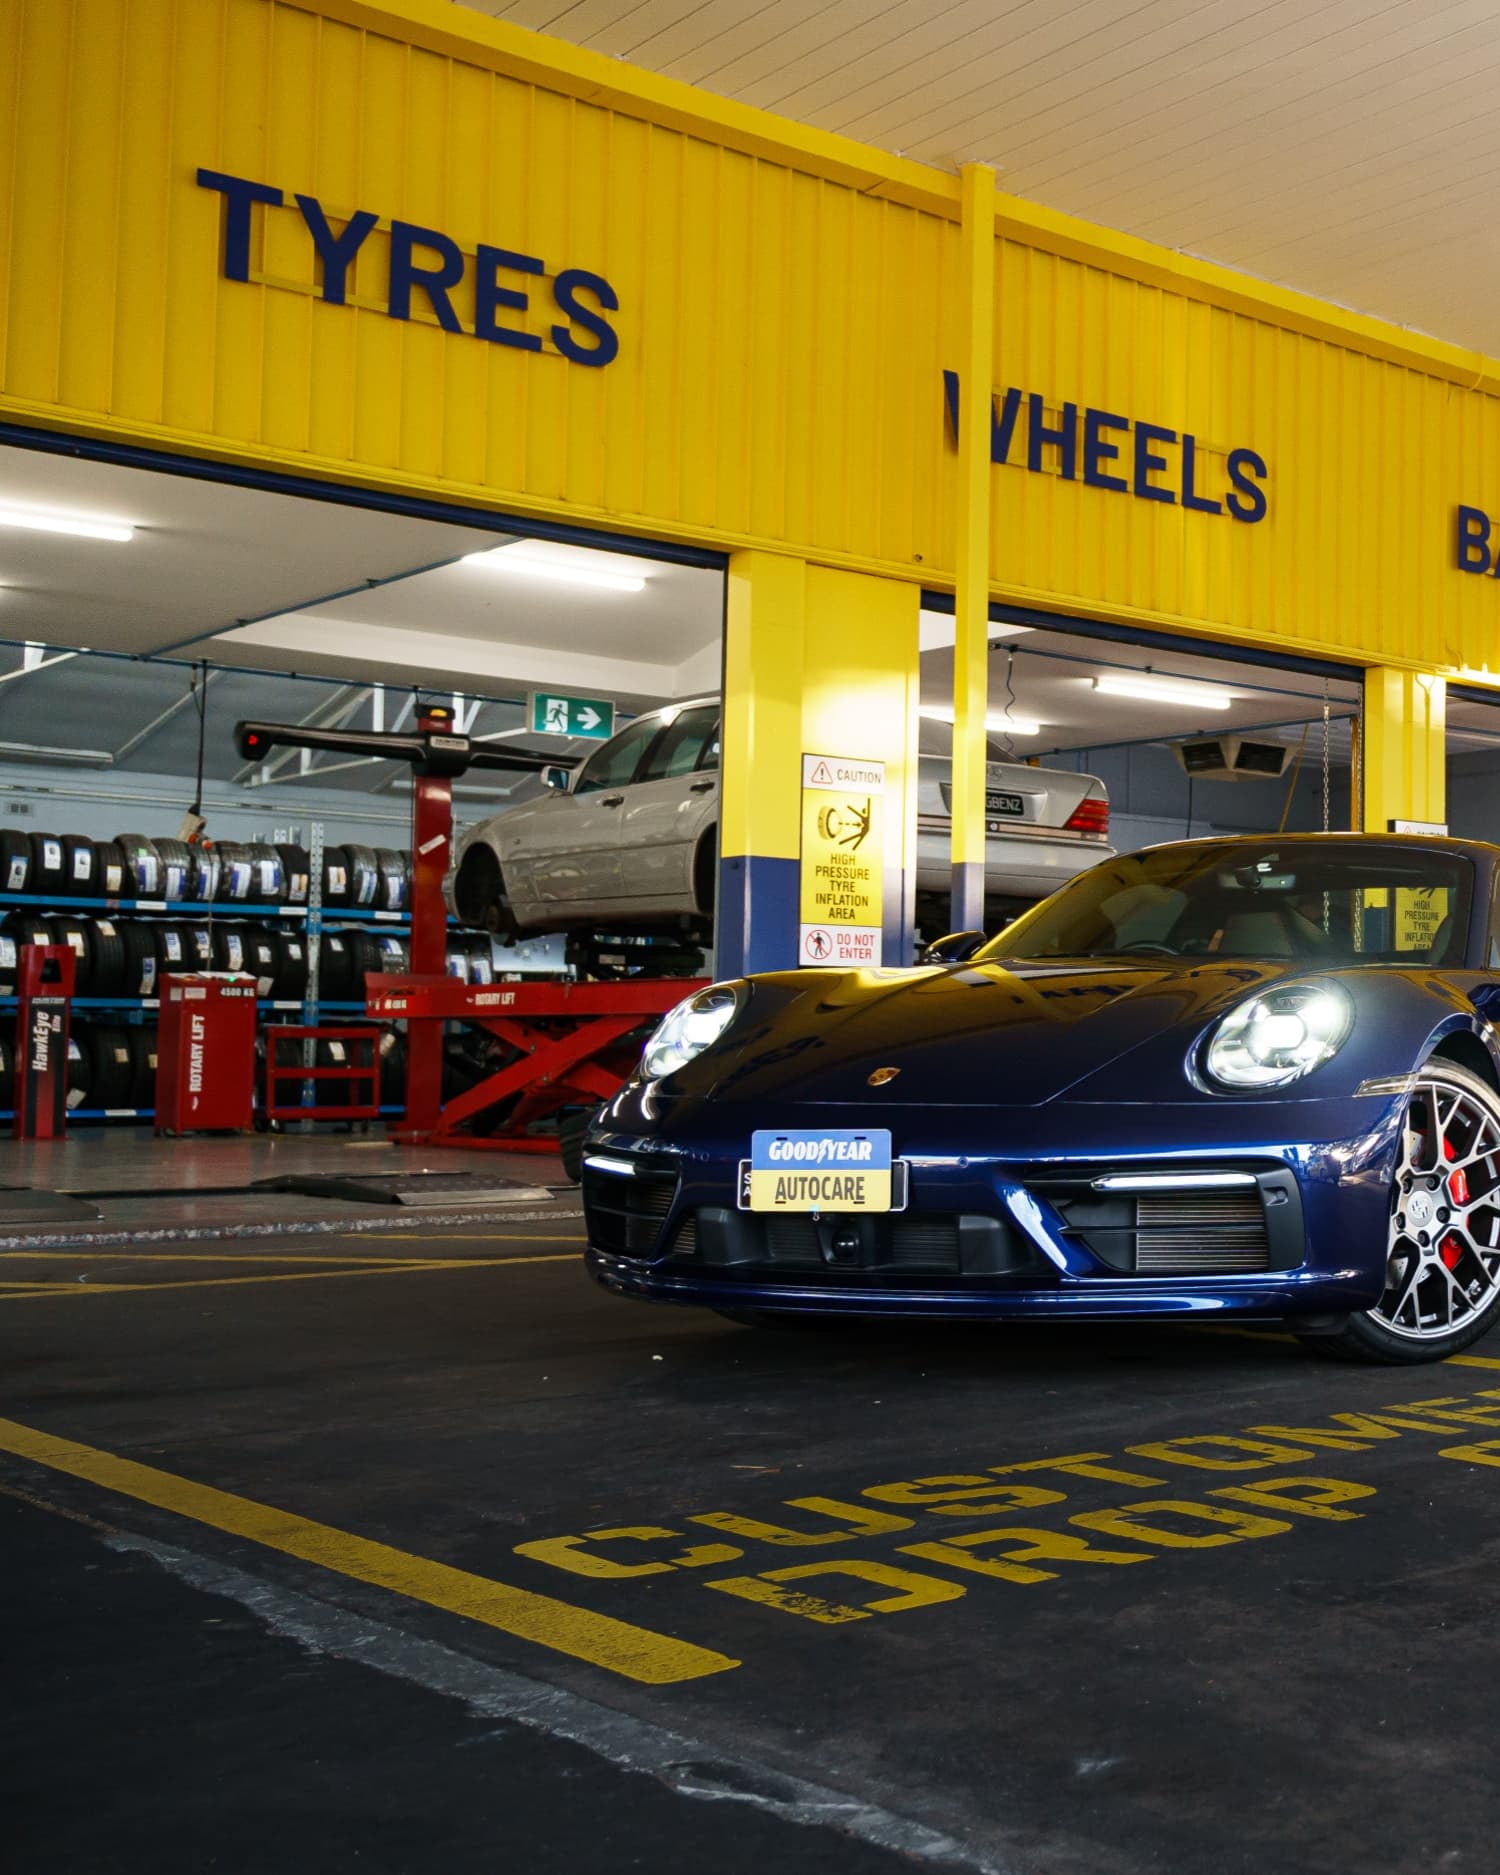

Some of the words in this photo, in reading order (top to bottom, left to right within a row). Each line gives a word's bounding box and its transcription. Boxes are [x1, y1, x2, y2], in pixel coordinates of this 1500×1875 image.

[197, 168, 619, 368] TYRES
[943, 369, 1267, 523] WHEELS
[836, 769, 882, 784] CAUTION
[830, 853, 856, 866] HIGH
[815, 866, 870, 881] PRESSURE
[830, 880, 856, 893] TYRE
[815, 893, 869, 907] INFLATION
[1413, 900, 1431, 911] HIGH
[828, 907, 856, 920] AREA
[1404, 910, 1440, 922] PRESSURE
[1413, 921, 1431, 932] TYRE
[836, 933, 853, 946] DO
[854, 934, 875, 947] NOT
[1404, 932, 1434, 943] INFLATIO
[839, 948, 873, 960] ENTER
[220, 987, 241, 997] 4500
[475, 993, 500, 1005] ROTARY
[501, 992, 515, 1004] LIFT
[192, 1014, 205, 1040] LIFT
[32, 1011, 50, 1071] HawkEye
[189, 1043, 204, 1092] ROTARY
[769, 1139, 872, 1164] GOODYEAR
[775, 1176, 865, 1201] AUTOCARE
[704, 1476, 1377, 1623] DROP
